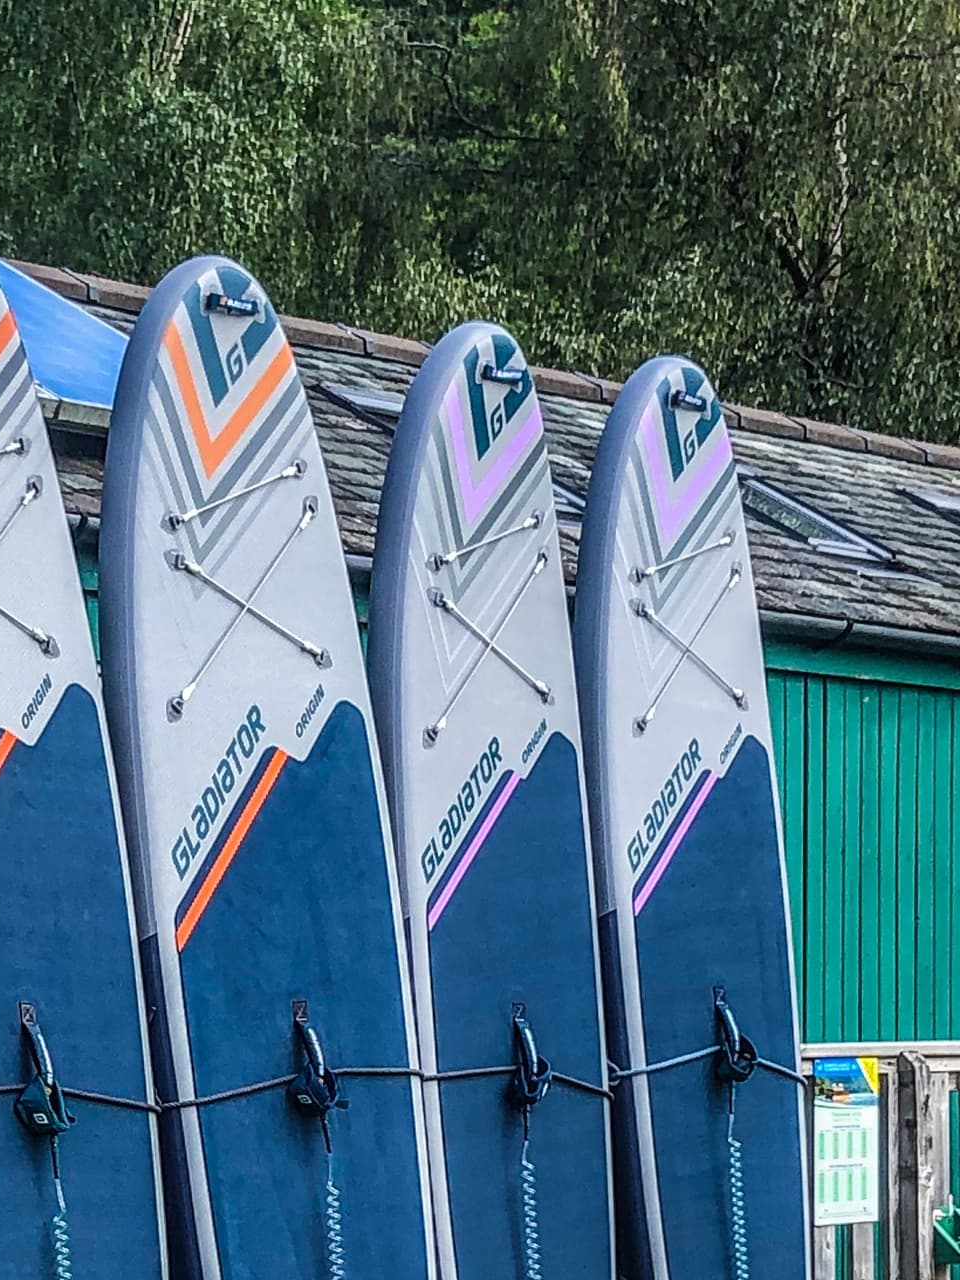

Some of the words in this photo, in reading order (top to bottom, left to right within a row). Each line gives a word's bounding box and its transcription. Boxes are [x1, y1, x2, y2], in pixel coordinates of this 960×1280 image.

[21, 673, 53, 730] ORIGIN
[295, 684, 325, 738] ORIGIN
[521, 718, 547, 764] ORIGIN
